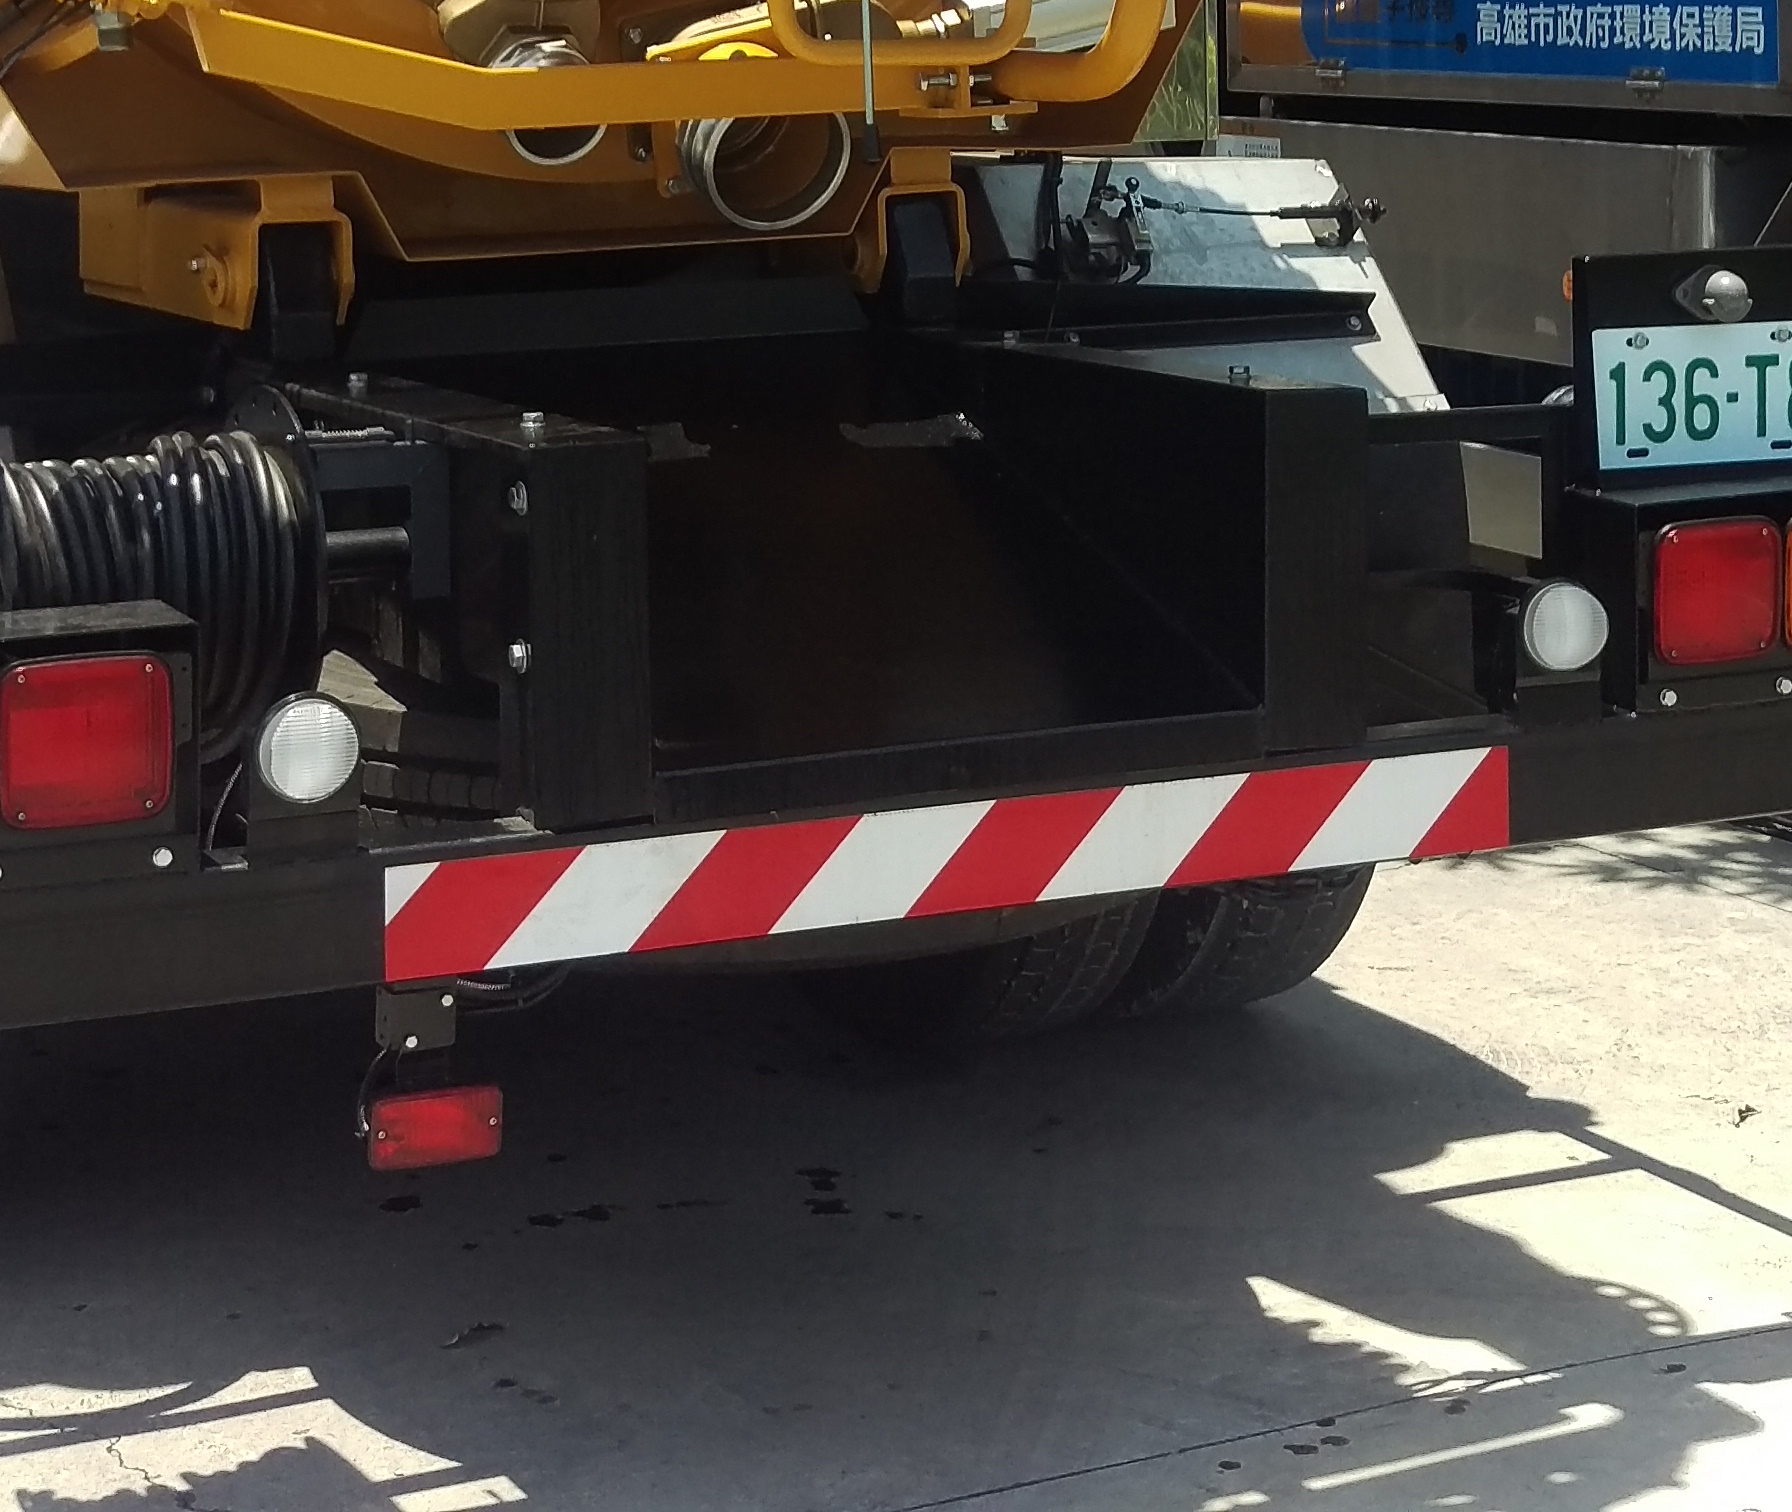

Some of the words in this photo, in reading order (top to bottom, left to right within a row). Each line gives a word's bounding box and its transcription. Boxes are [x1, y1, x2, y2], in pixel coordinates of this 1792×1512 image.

[1476, 1, 1765, 55] 高雄市政府環境保護局
